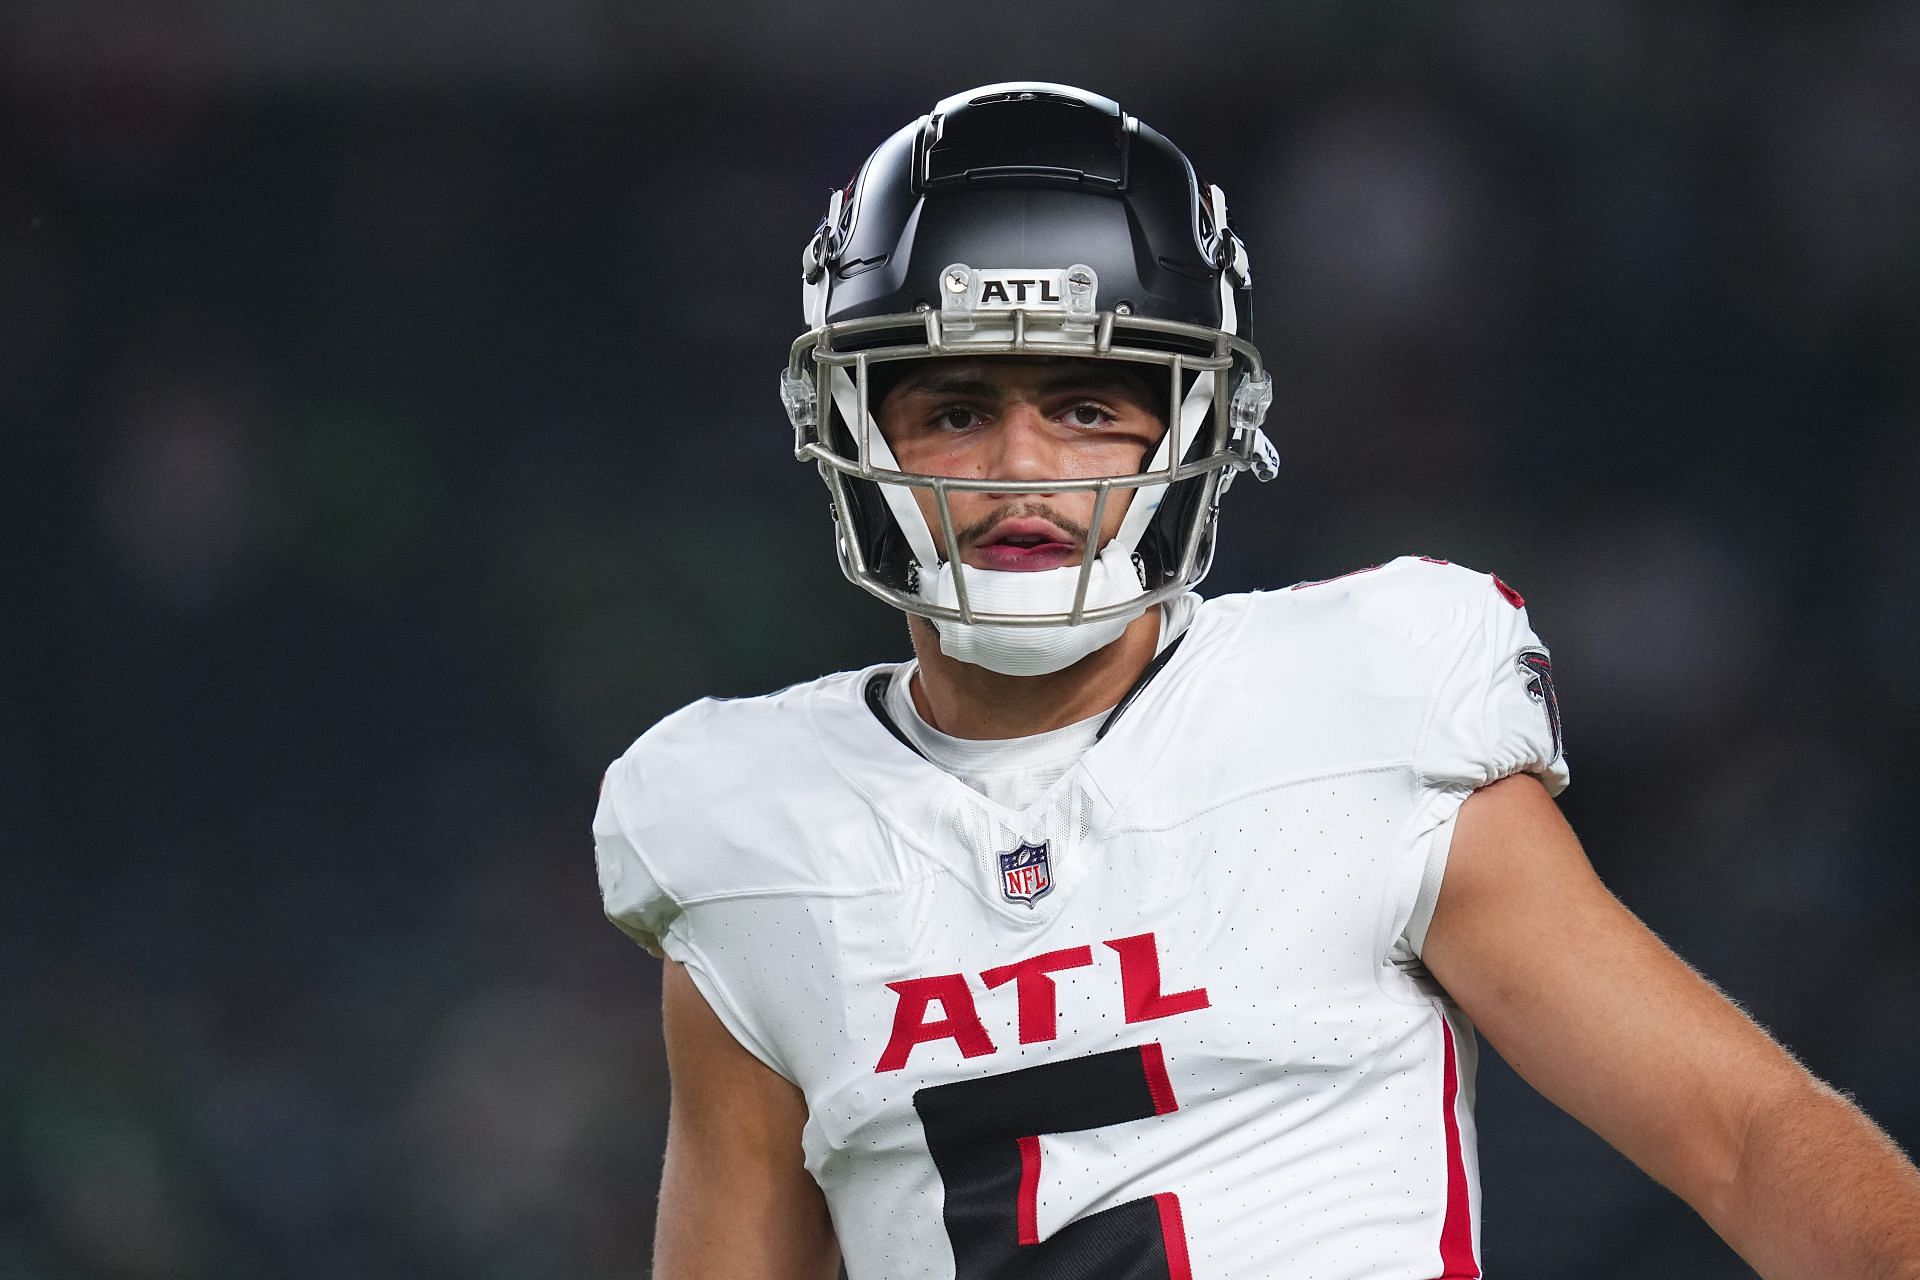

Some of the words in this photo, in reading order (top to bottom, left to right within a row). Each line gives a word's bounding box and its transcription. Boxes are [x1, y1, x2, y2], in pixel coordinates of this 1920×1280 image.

[981, 279, 1060, 303] ATL
[1007, 865, 1047, 895] NFL
[875, 932, 1210, 1074] ATL
